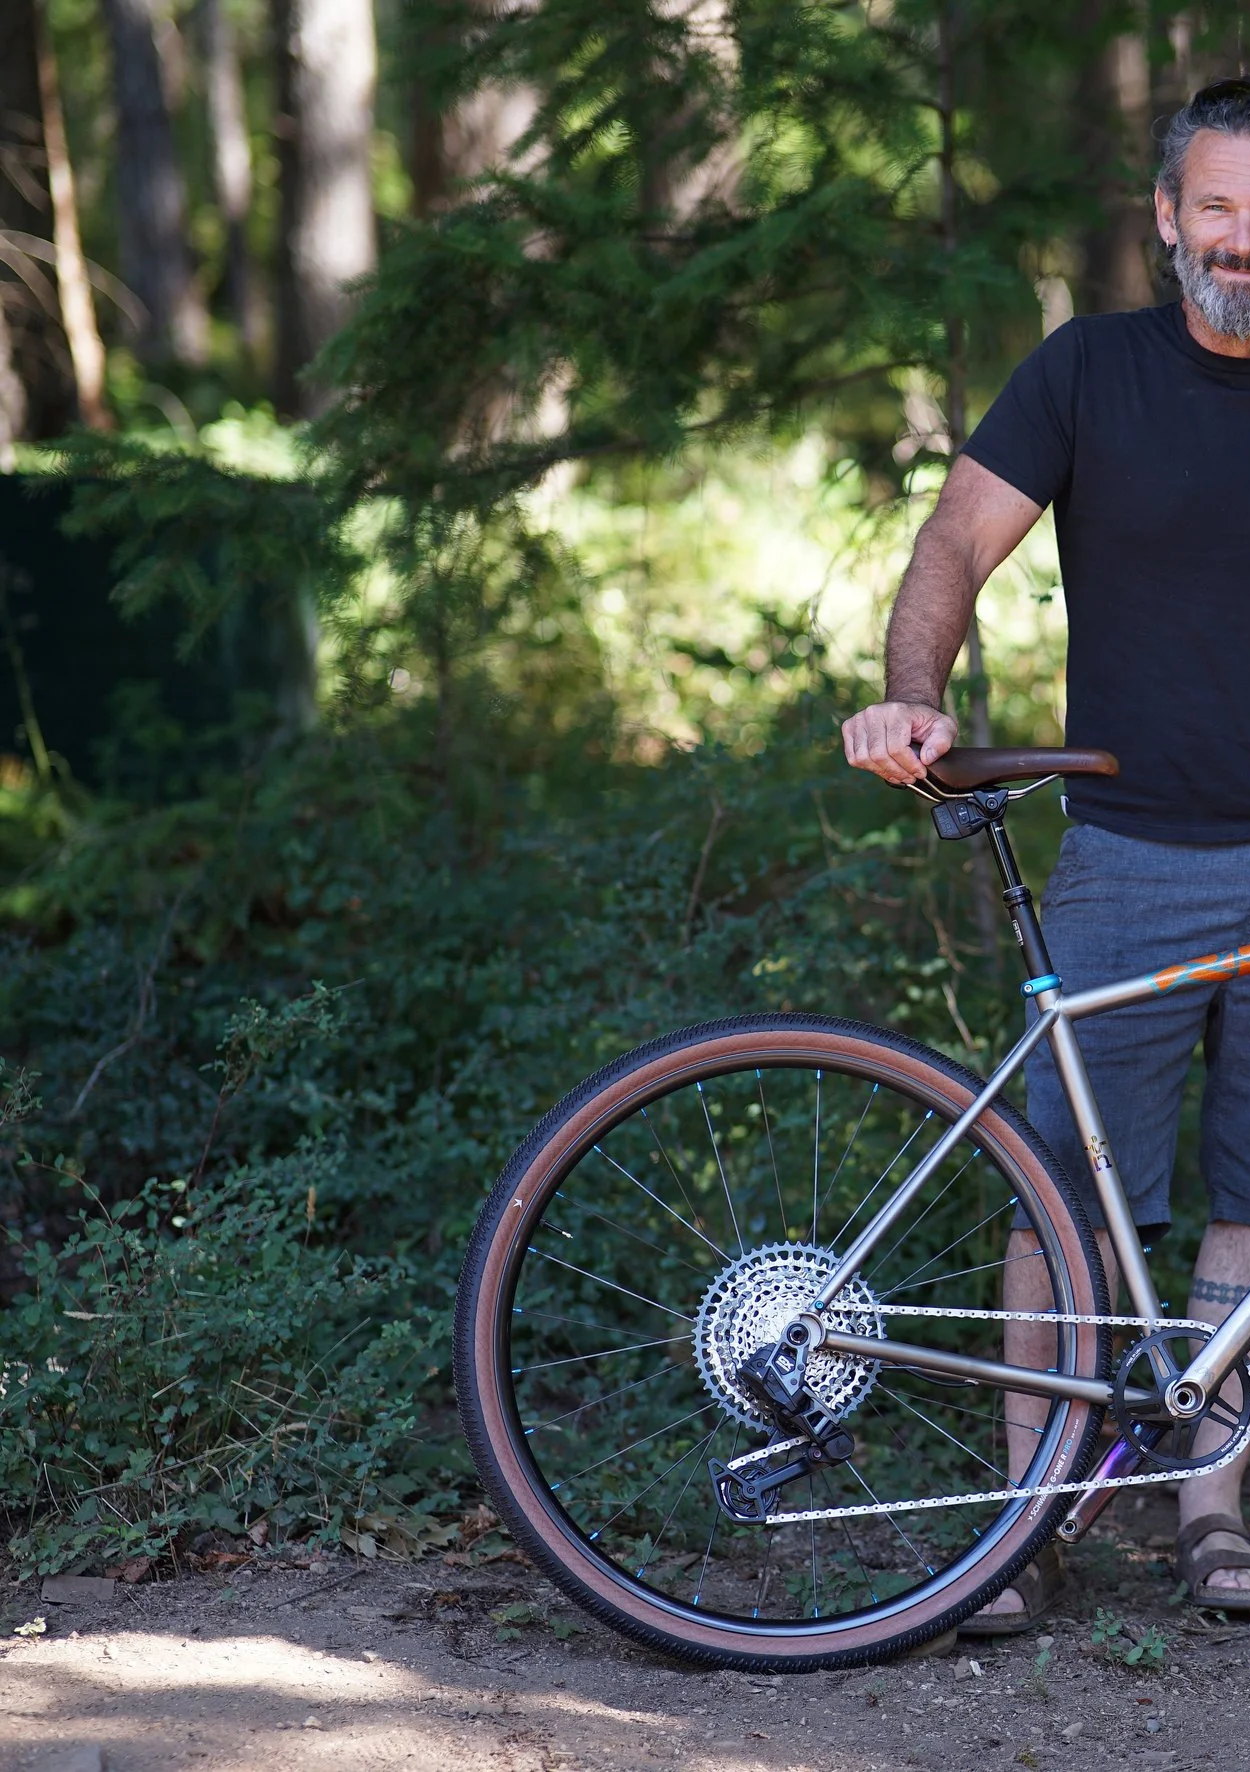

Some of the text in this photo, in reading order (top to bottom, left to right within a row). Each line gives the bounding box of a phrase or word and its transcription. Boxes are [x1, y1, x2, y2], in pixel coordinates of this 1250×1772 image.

[1030, 1438, 1073, 1517] SCHWAE G-ONE R PRO
